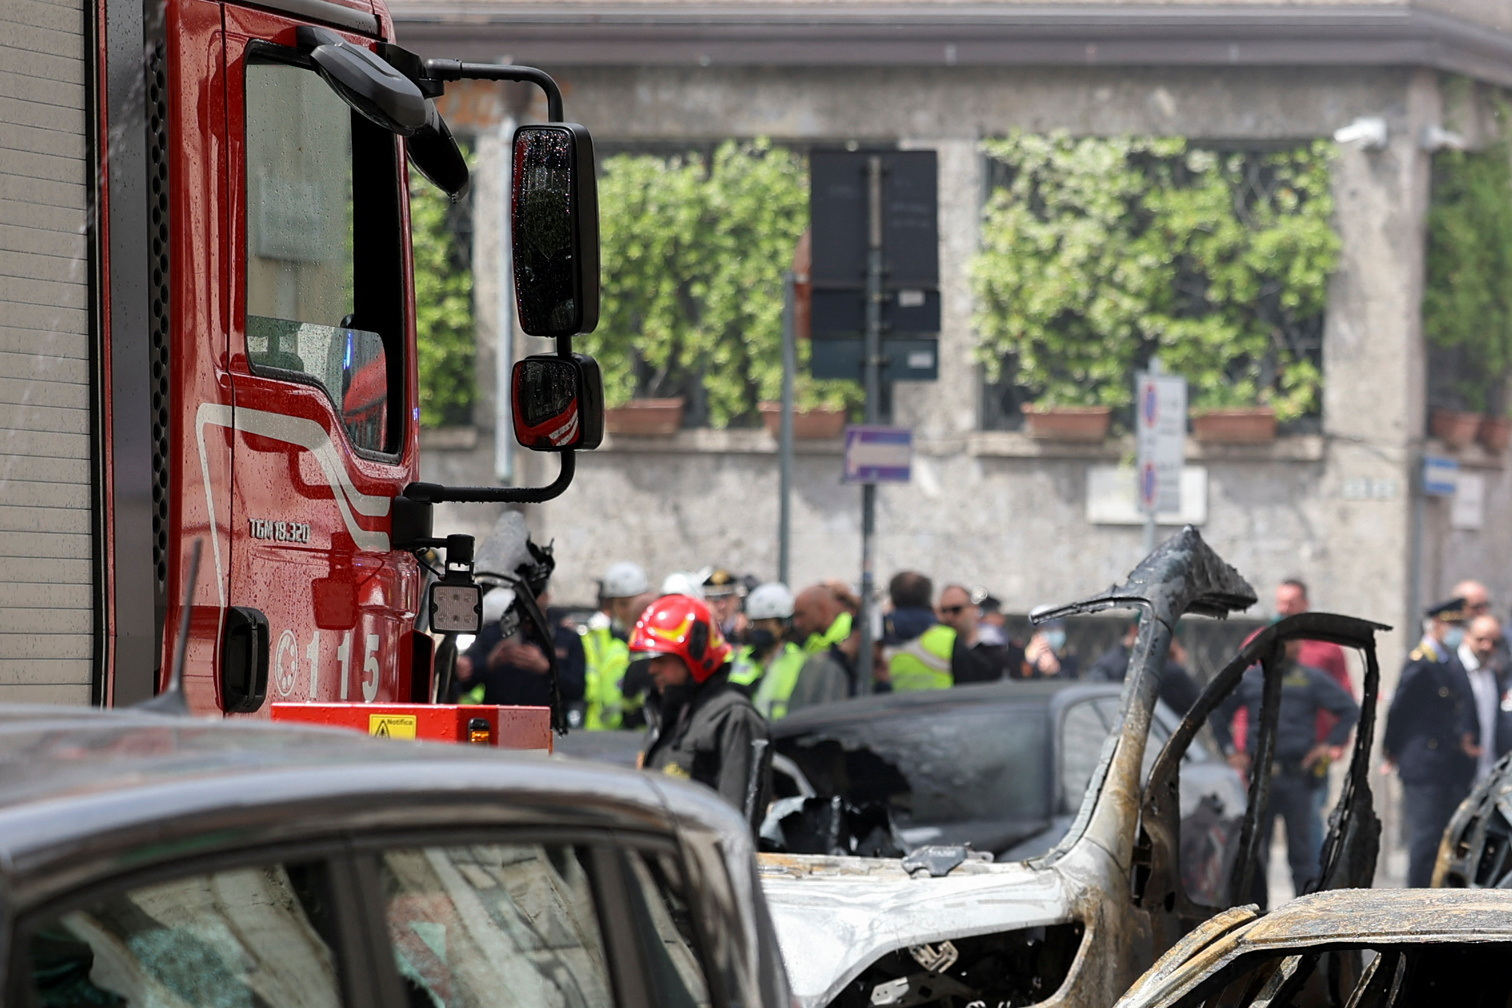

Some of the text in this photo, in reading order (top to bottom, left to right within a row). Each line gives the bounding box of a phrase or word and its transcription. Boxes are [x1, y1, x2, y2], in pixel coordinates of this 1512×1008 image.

[248, 518, 311, 544] TGM 18.320
[387, 718, 413, 726] Notifica
